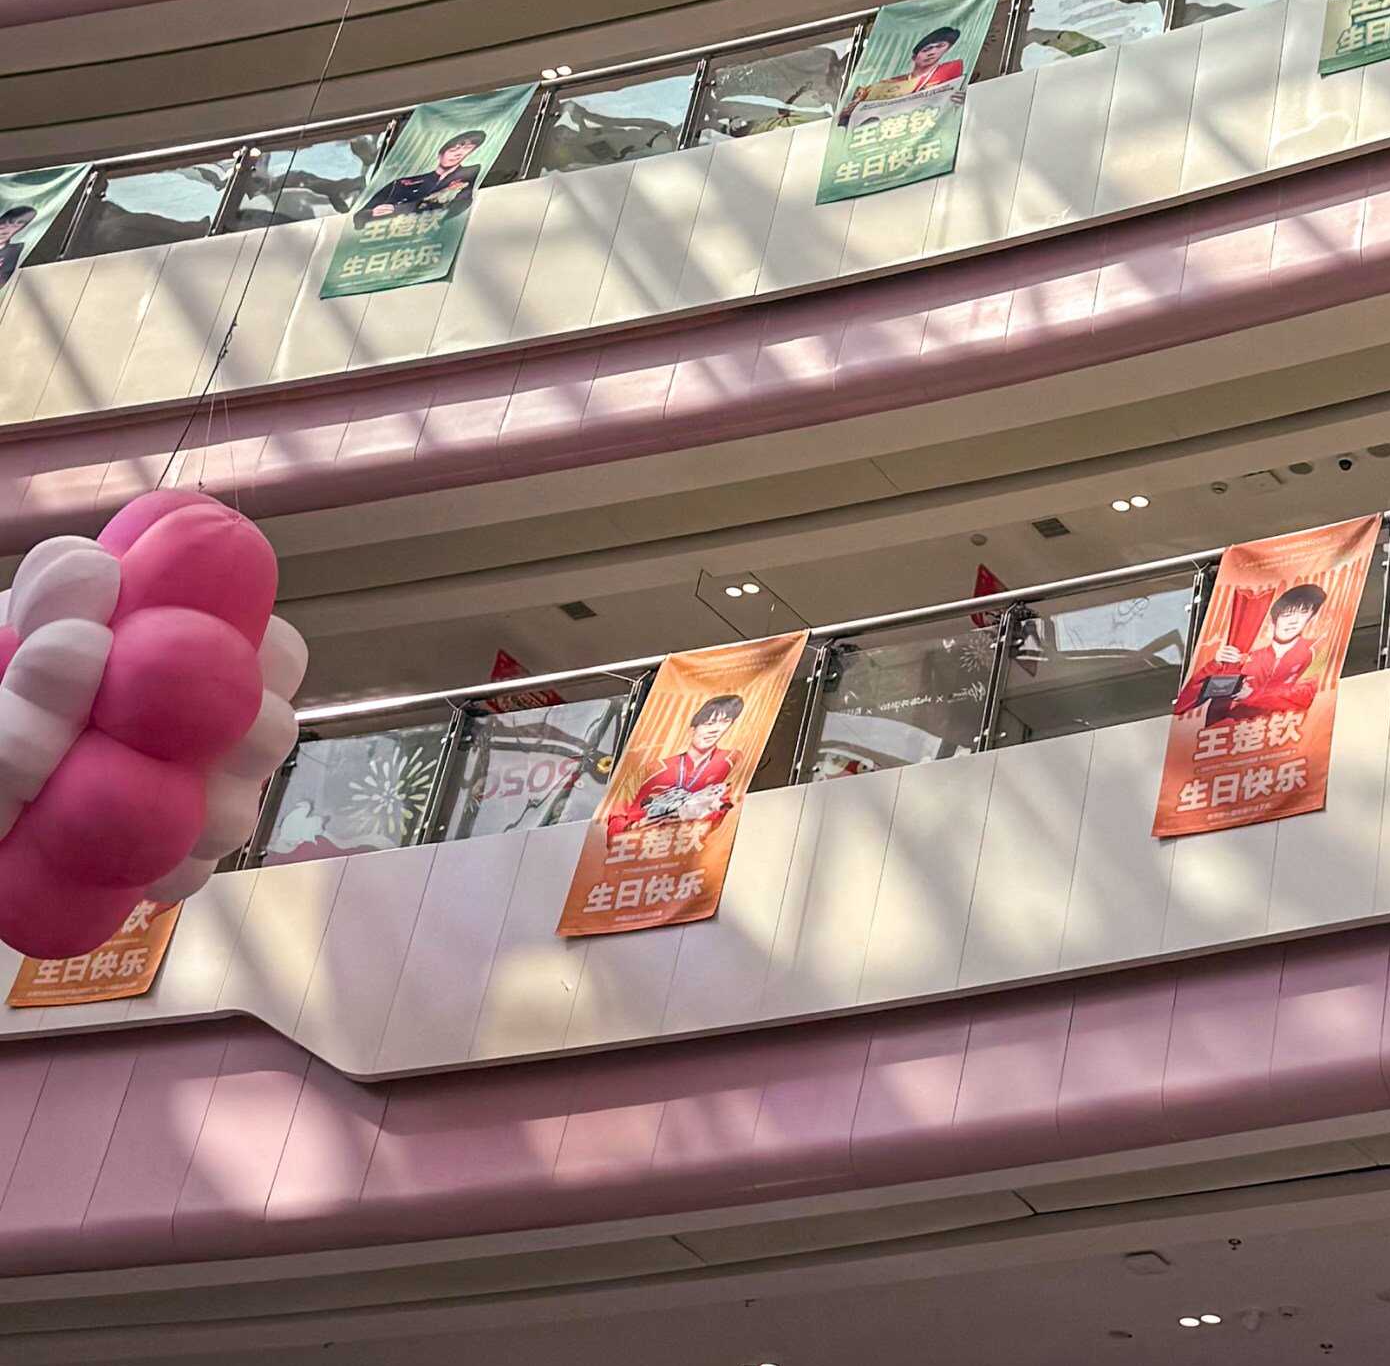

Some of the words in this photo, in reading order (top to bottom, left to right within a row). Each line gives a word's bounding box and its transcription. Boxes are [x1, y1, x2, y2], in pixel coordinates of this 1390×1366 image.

[850, 107, 942, 150] 王楚钦
[833, 138, 942, 184] 生日快乐
[359, 210, 446, 244] 王楚钦
[340, 243, 443, 278] 生日快乐
[1194, 711, 1305, 762] 王楚钦
[1175, 759, 1308, 813] 生日快乐
[605, 822, 709, 865] 王楚钦
[582, 868, 707, 914] 生日快乐
